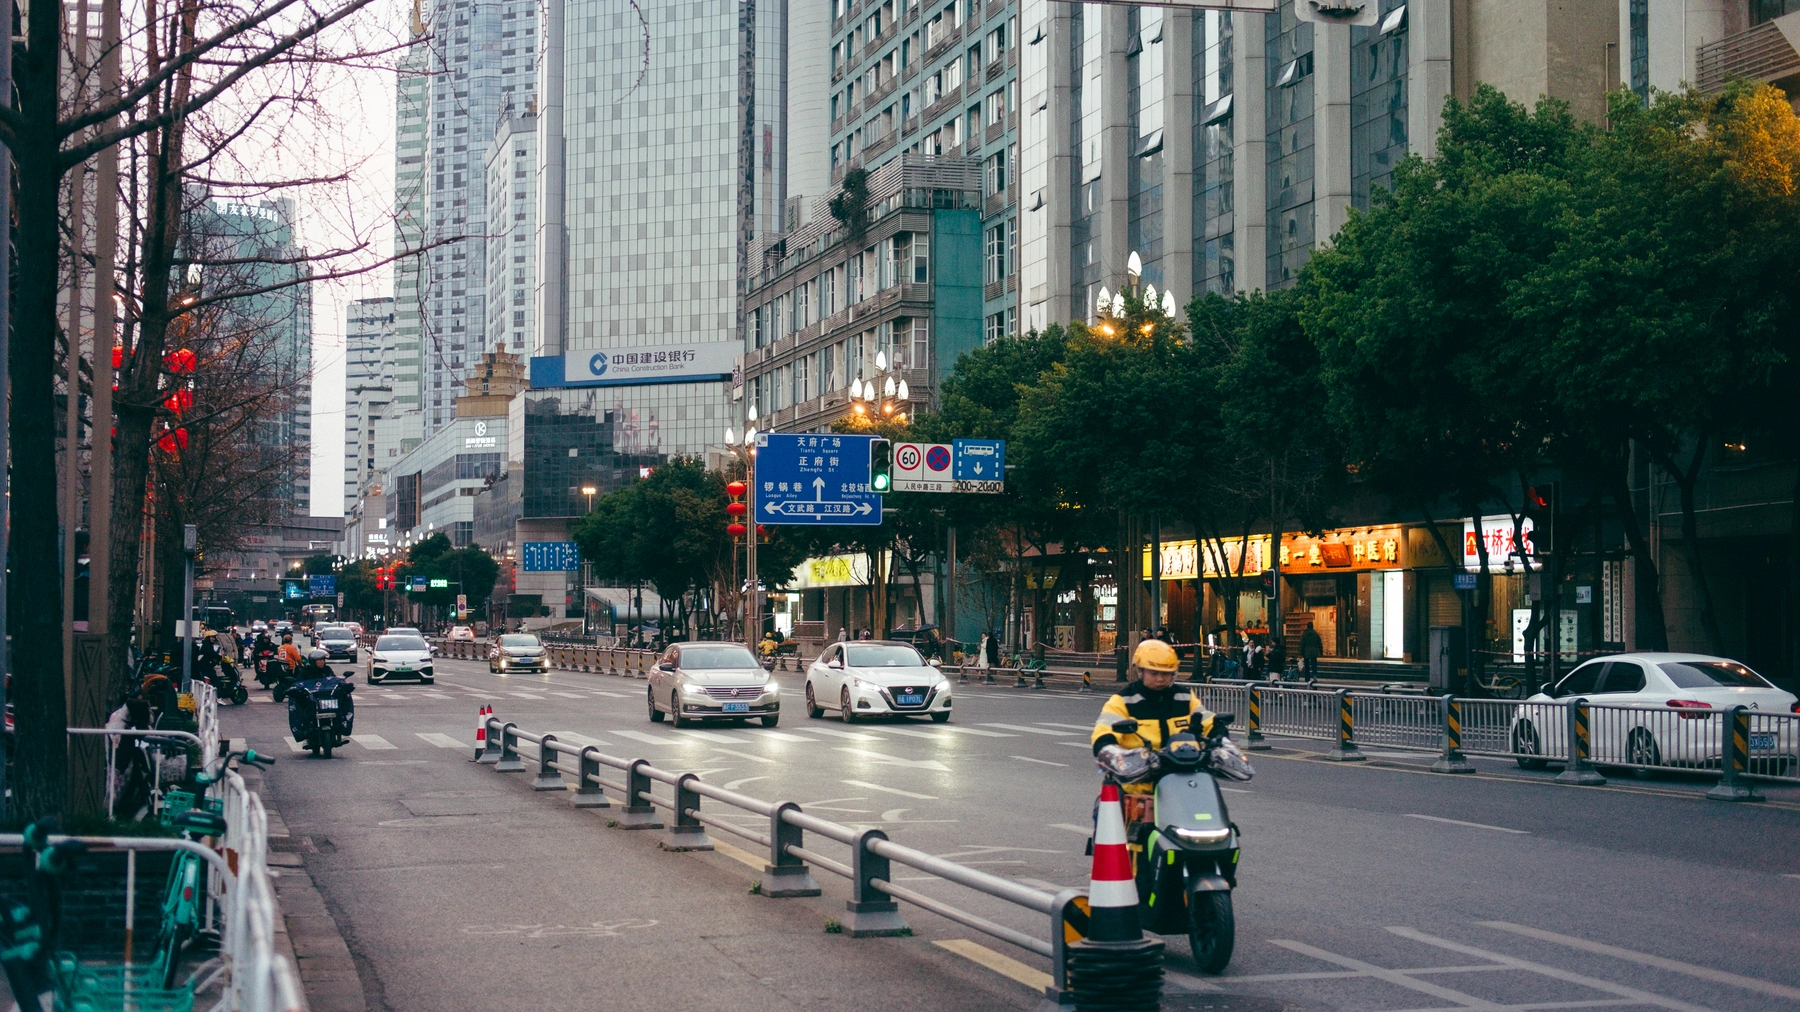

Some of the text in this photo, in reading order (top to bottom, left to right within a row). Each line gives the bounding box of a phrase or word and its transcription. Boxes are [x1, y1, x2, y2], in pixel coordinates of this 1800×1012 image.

[613, 350, 695, 365] 中国建设银行
[631, 364, 669, 372] Construction
[797, 437, 841, 447] 天府广场
[798, 456, 839, 467] 正府街
[902, 451, 916, 465] 60
[904, 482, 943, 491] 人民中路三段
[787, 504, 851, 513] 文武路 江汉路
[1353, 538, 1398, 562] 中医馆
